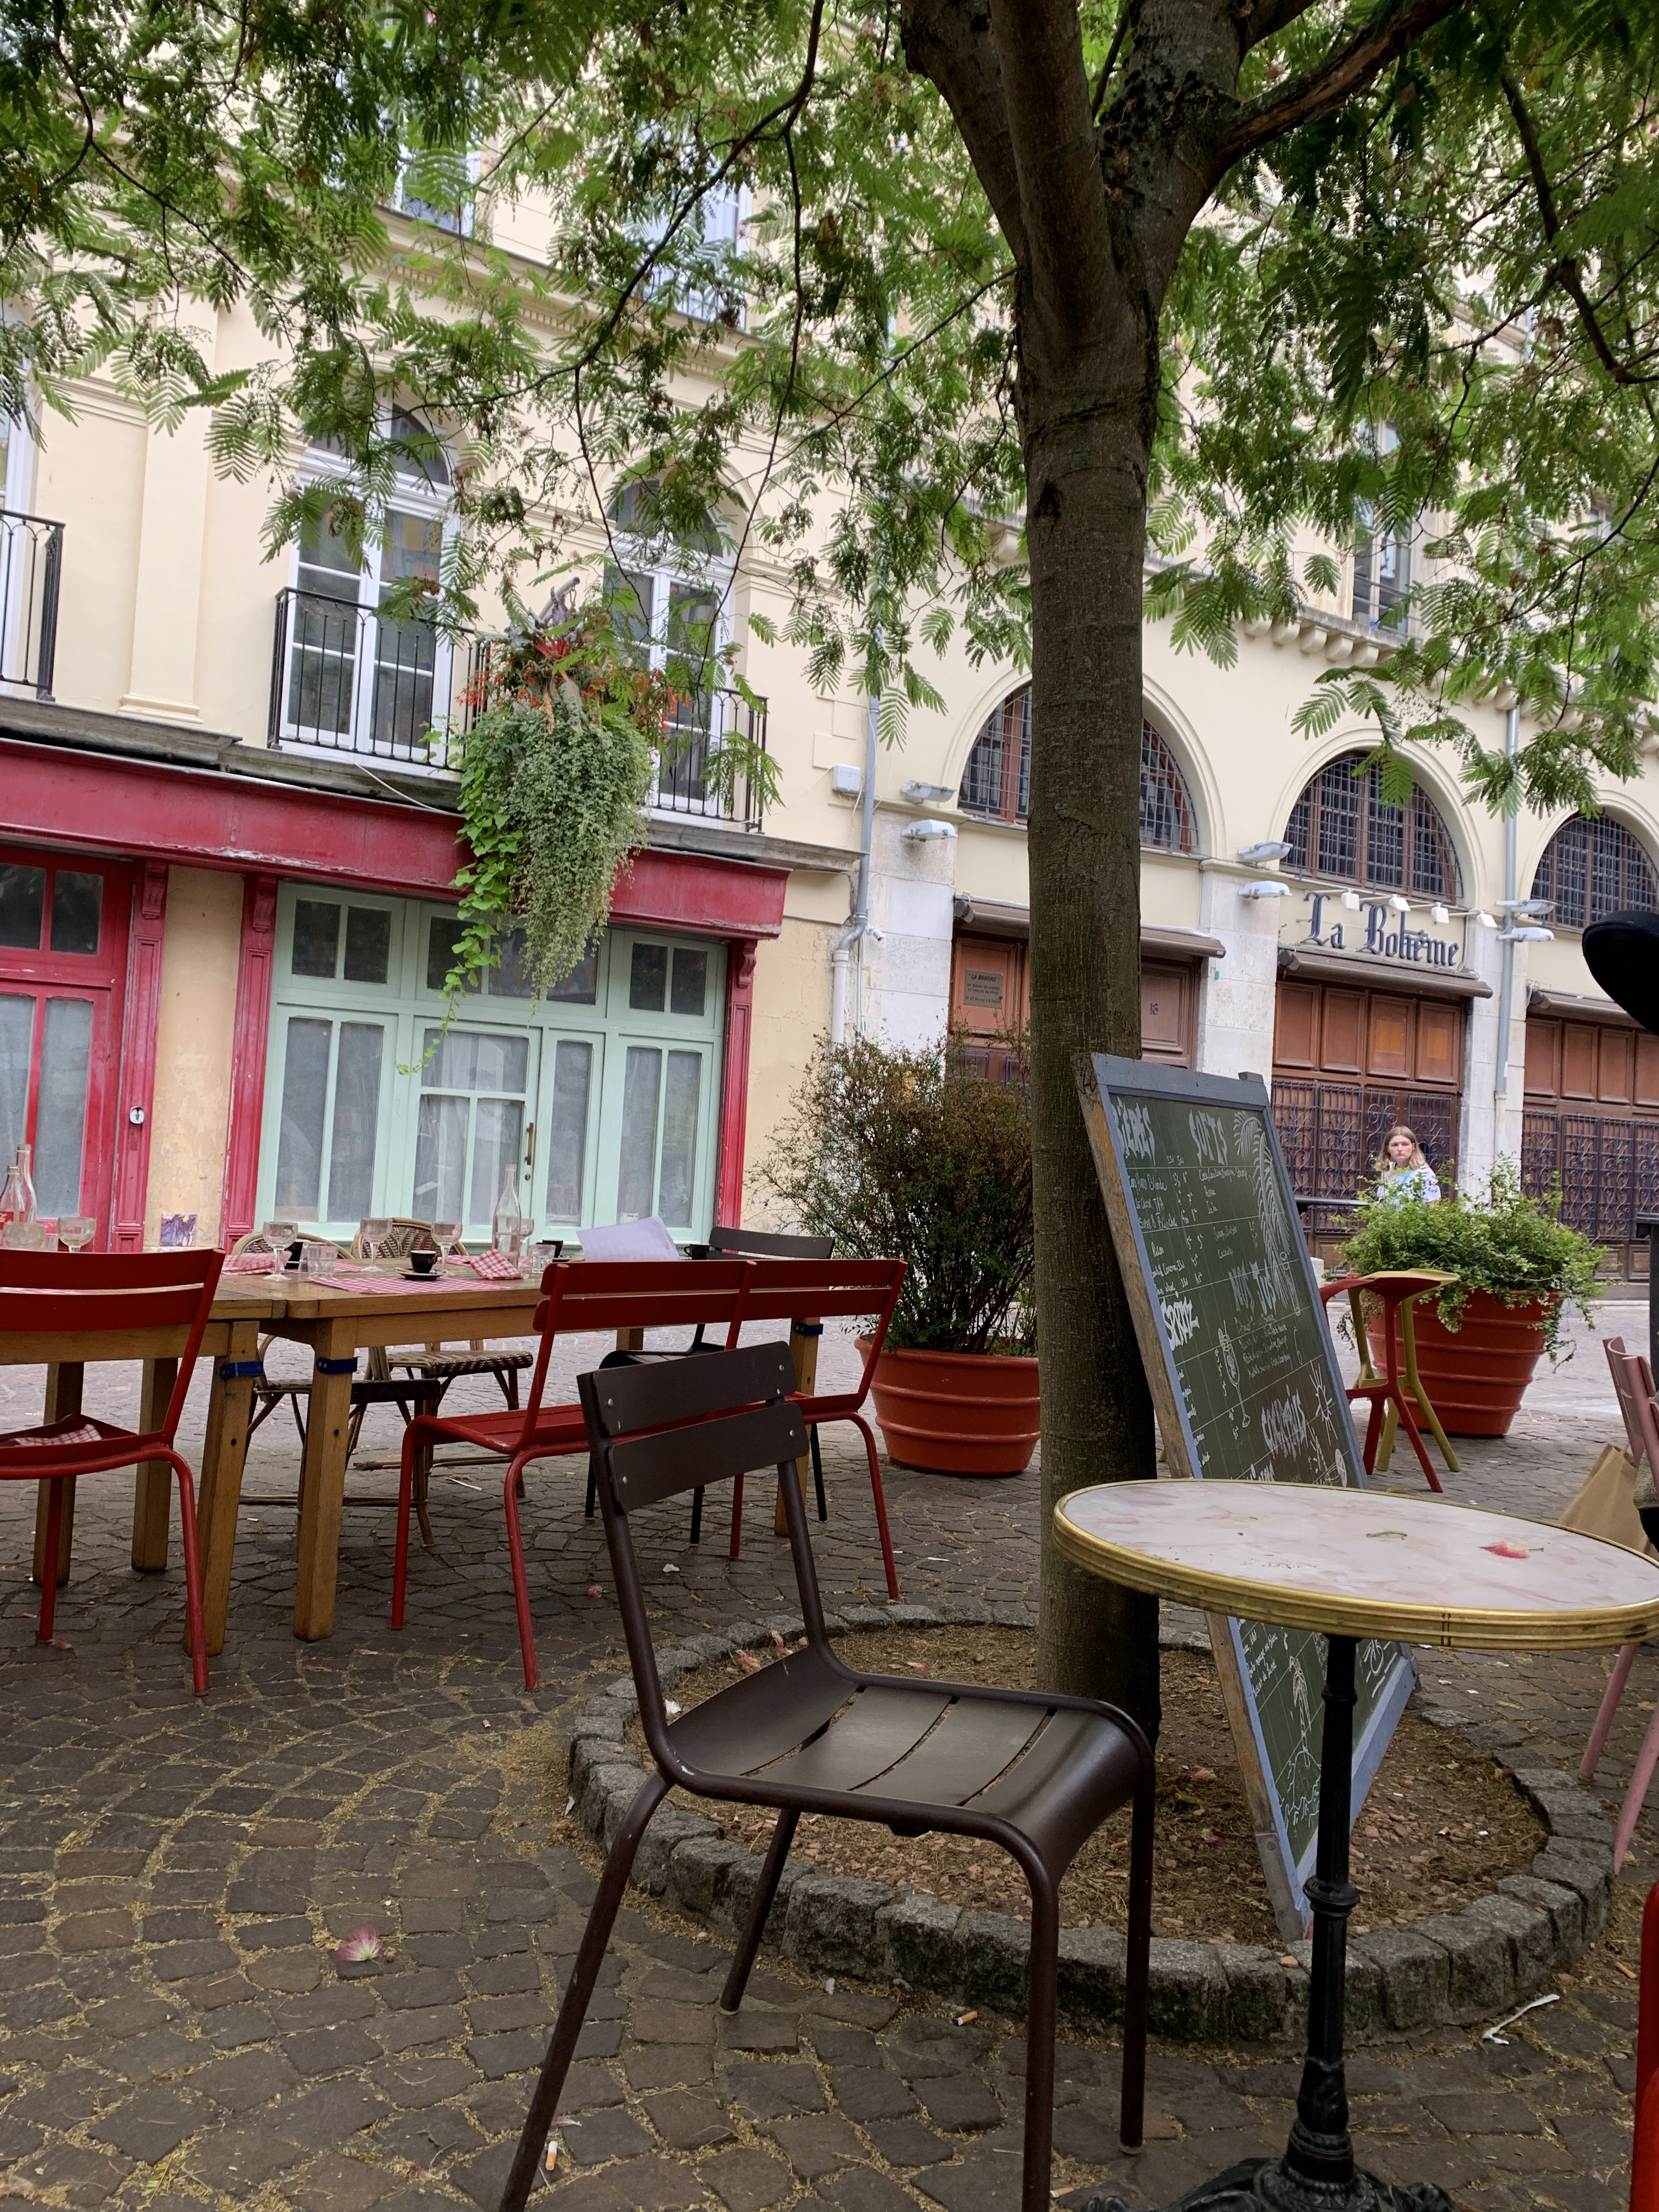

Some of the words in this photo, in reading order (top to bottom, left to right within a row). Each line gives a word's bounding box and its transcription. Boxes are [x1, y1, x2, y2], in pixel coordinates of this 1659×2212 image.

[1301, 891, 1347, 949] La
[1188, 1109, 1228, 1167] SOFTS
[1228, 1260, 1255, 1316] NOS
[1249, 1257, 1277, 1316] JUS
[1160, 1290, 1200, 1351] SPRITZ
